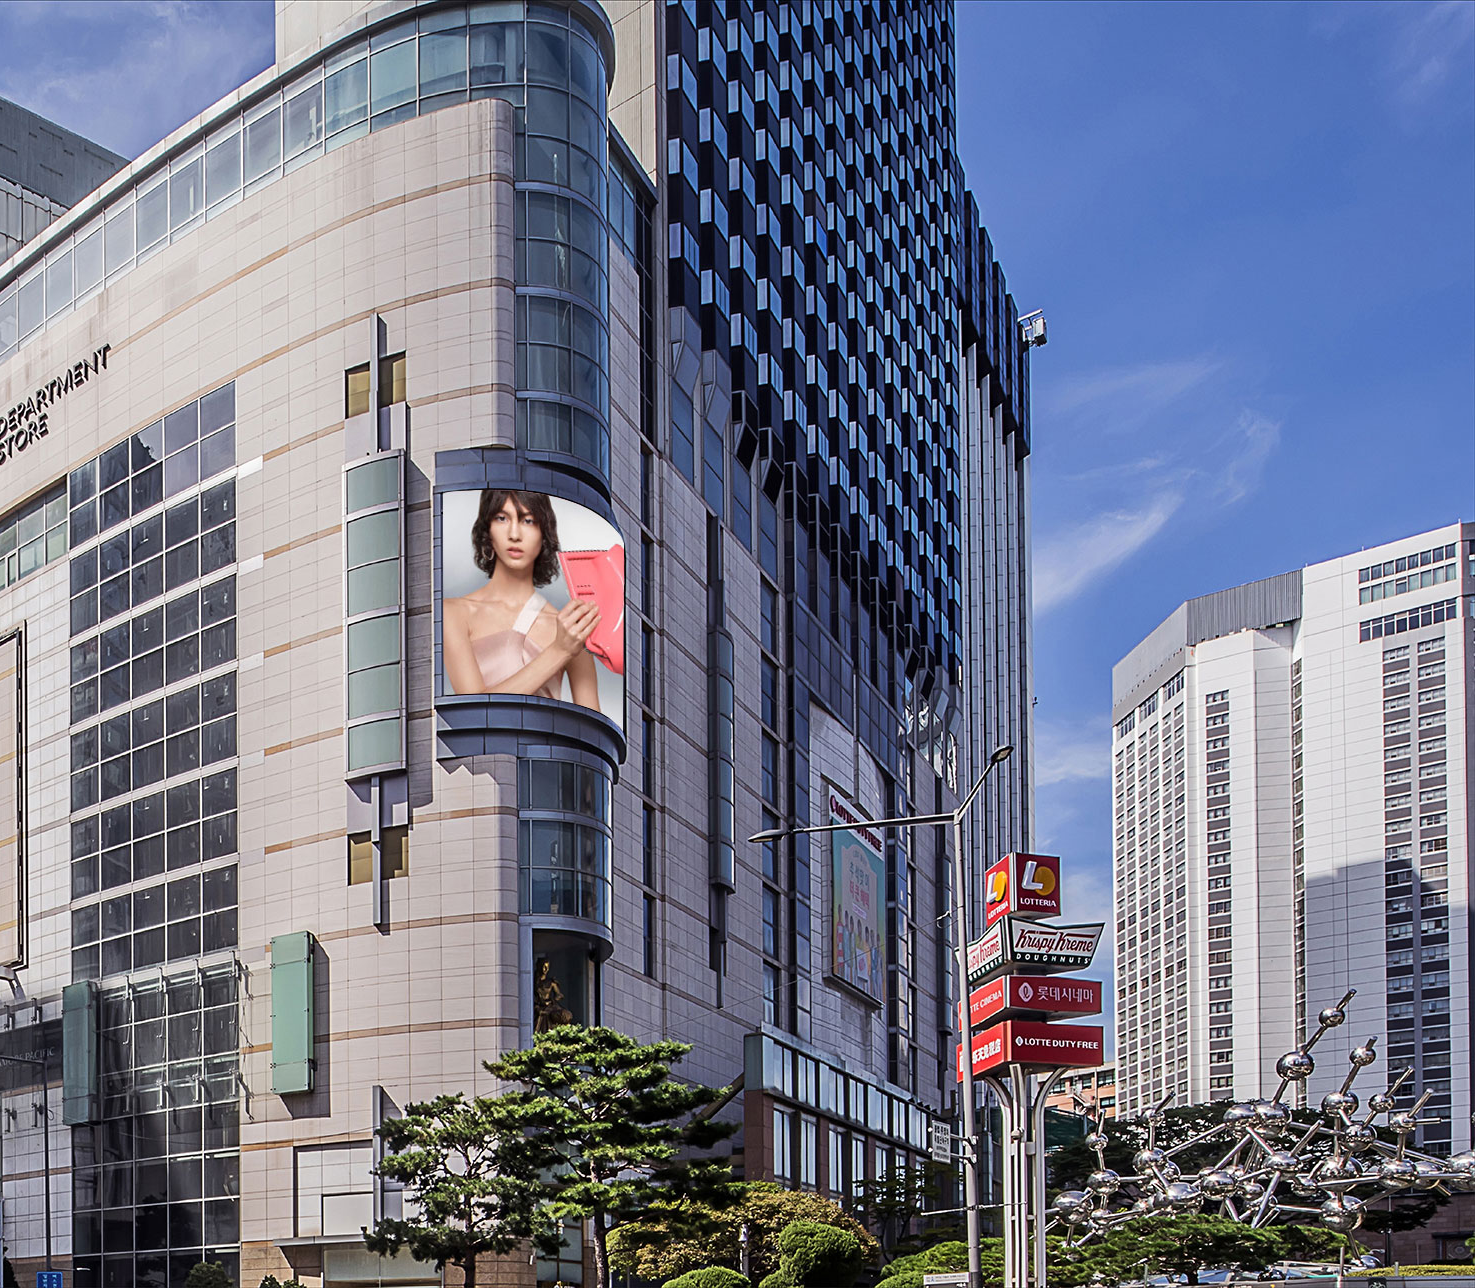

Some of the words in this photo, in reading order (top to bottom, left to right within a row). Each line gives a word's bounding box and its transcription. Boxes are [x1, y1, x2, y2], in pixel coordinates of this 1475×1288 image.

[1020, 897, 1057, 907] LOTTERIA
[1015, 929, 1057, 953] Krispy
[1054, 931, 1097, 952] Kreme
[1016, 953, 1090, 964] DOUGHNUTS
[980, 990, 1002, 1008] CINEMA
[1037, 986, 1093, 1003] 롯데시네마
[1025, 1038, 1051, 1047] LOTTE
[1052, 1039, 1076, 1048] DUTY
[1077, 1041, 1099, 1049] FREE
[25, 1047, 55, 1060] PACIFIC
